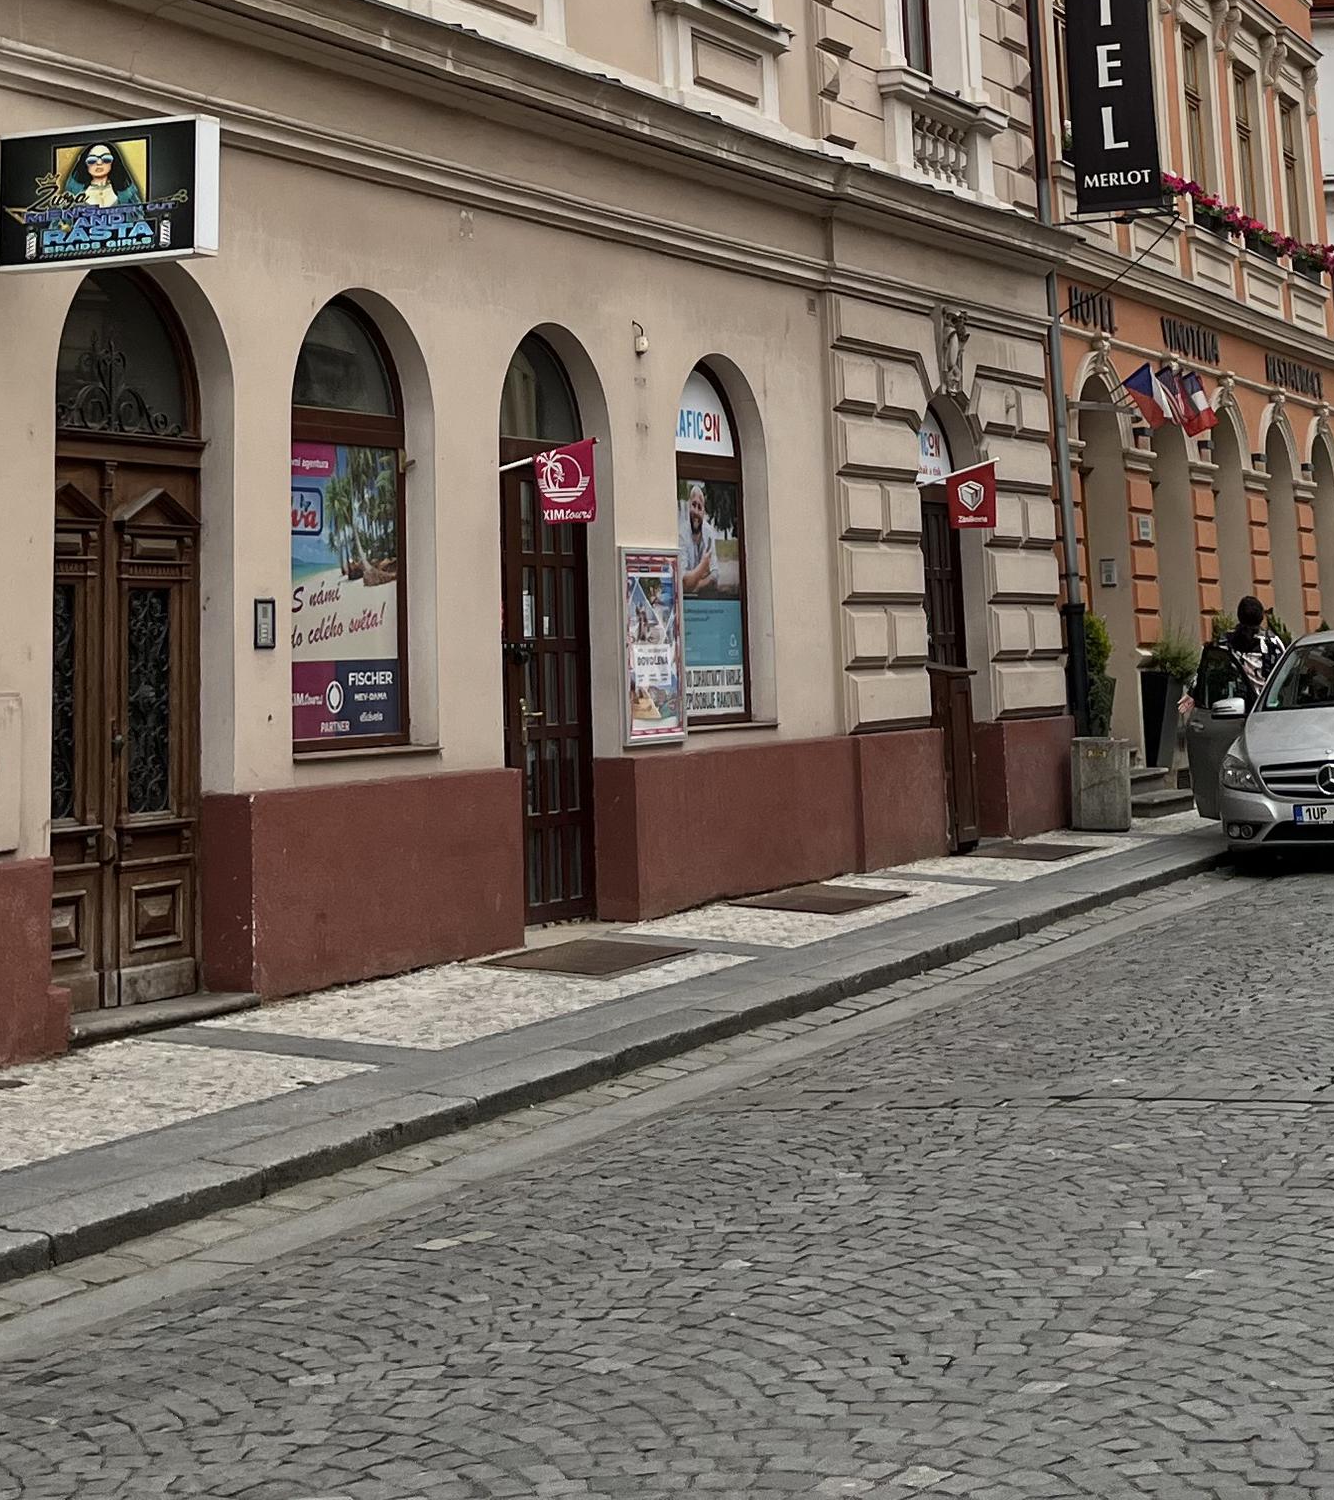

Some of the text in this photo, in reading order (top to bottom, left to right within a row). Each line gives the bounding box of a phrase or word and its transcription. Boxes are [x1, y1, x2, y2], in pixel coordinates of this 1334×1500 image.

[1084, 169, 1152, 188] MERLOT
[146, 201, 177, 212] CUT
[72, 211, 126, 229] AND
[43, 221, 155, 246] RASTA
[43, 236, 153, 254] BRAIDS GIRLS
[1068, 285, 1117, 335] HOTEL
[676, 409, 721, 443] AFICON
[291, 580, 341, 613] S námi
[308, 611, 344, 645] celého
[348, 601, 387, 633] světa!
[348, 671, 394, 687] FISCHER
[320, 721, 350, 733] PARTNER
[1305, 807, 1327, 820] 1UP
